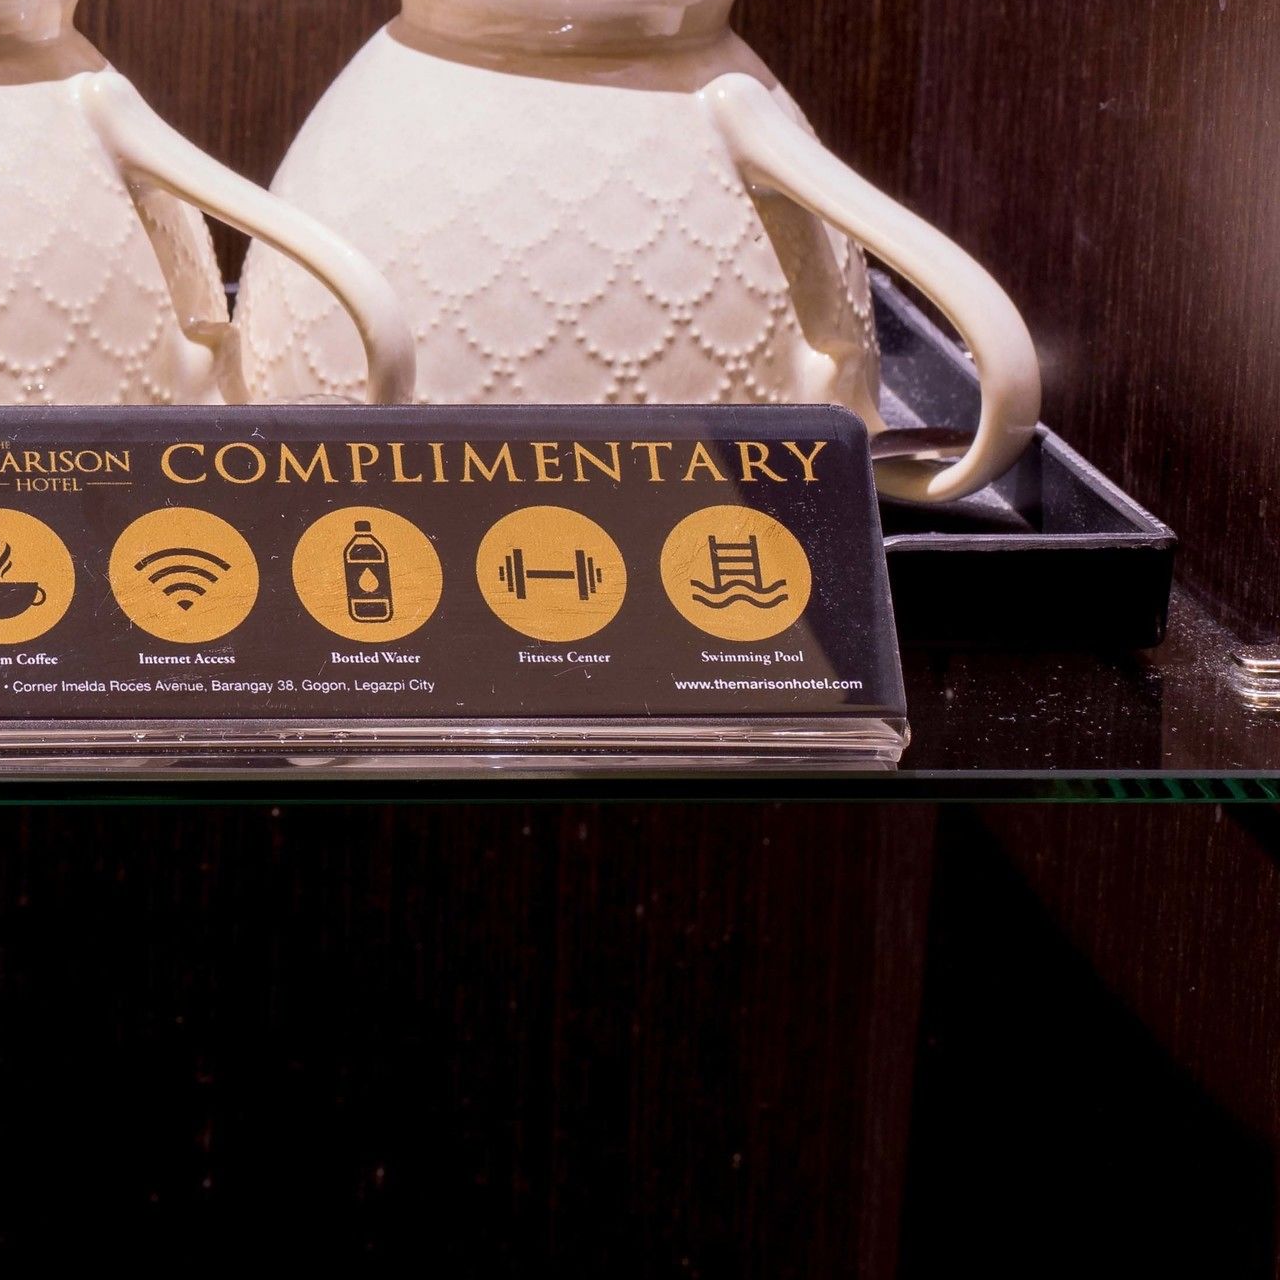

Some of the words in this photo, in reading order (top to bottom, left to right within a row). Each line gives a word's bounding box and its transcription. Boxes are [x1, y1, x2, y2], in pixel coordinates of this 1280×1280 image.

[159, 440, 828, 485] COMPLIMENTARY
[15, 477, 83, 493] HOTEL
[16, 652, 59, 666] Coffee
[138, 652, 190, 665] Internet
[193, 651, 236, 665] Access
[330, 651, 380, 664] Bottled
[381, 651, 421, 664] Water
[517, 650, 565, 664] Fitness
[566, 650, 611, 664] Center
[700, 650, 772, 666] Swimming
[774, 650, 804, 663] Pool
[12, 680, 58, 693] Corner
[61, 679, 107, 692] Imelda
[109, 679, 152, 692] Roces
[154, 679, 208, 694] Avenue,
[211, 679, 274, 694] Barangay
[276, 679, 298, 693] 38,
[301, 679, 351, 694] Gogon,
[354, 679, 406, 694] Legazpi
[409, 678, 436, 694] City
[674, 676, 864, 691] www.themarisonhotel.com
